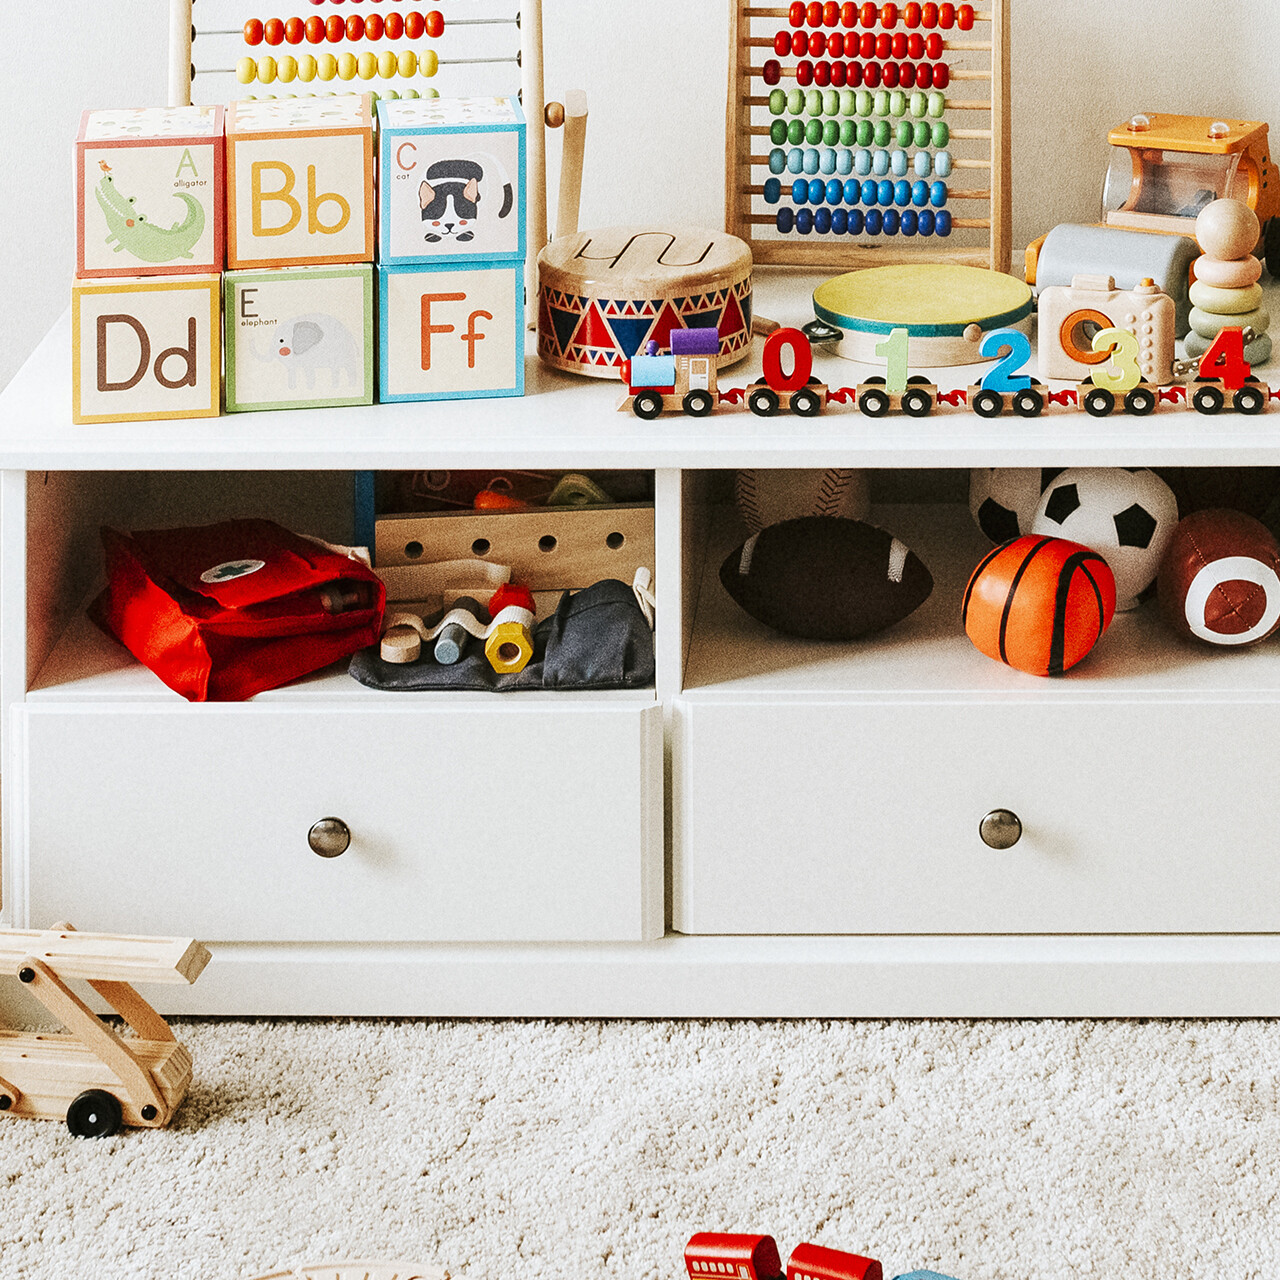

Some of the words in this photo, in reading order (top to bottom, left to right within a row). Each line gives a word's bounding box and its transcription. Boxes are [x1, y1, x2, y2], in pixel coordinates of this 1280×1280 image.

[175, 148, 199, 178] A
[396, 142, 417, 171] C
[173, 179, 208, 189] alligator
[251, 161, 352, 237] Bb
[241, 288, 258, 318] E
[241, 318, 278, 328] elephant
[419, 292, 494, 372] Ff
[95, 313, 197, 392] Dd
[762, 327, 813, 392] 0
[875, 327, 908, 394] 1
[979, 327, 1032, 393] 2
[1089, 327, 1142, 392] 3
[1199, 326, 1252, 388] 4
